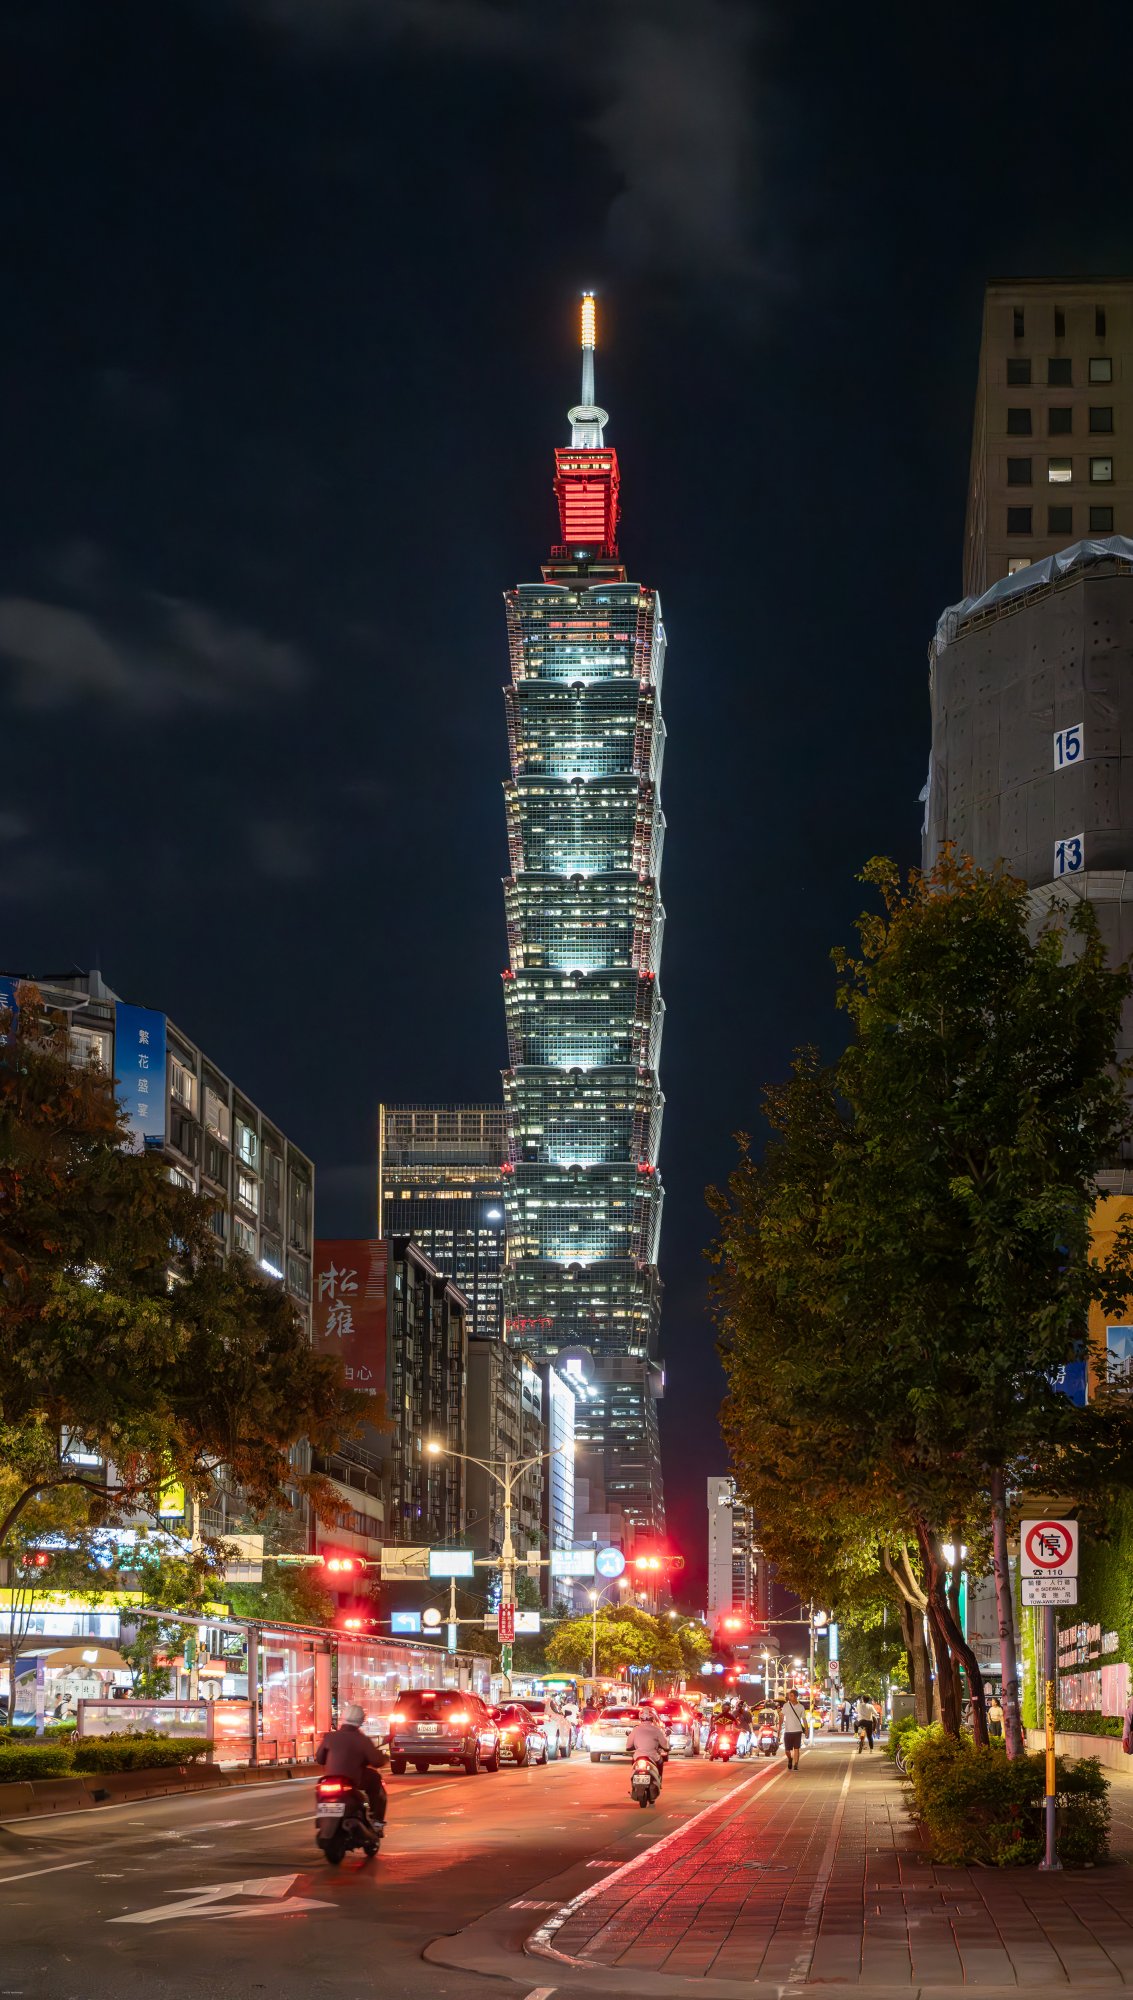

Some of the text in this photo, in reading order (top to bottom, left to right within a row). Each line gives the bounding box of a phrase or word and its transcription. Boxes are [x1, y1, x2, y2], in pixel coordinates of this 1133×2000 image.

[1056, 727, 1080, 765] 15
[1056, 837, 1082, 874] 13
[1039, 1534, 1061, 1556] 停
